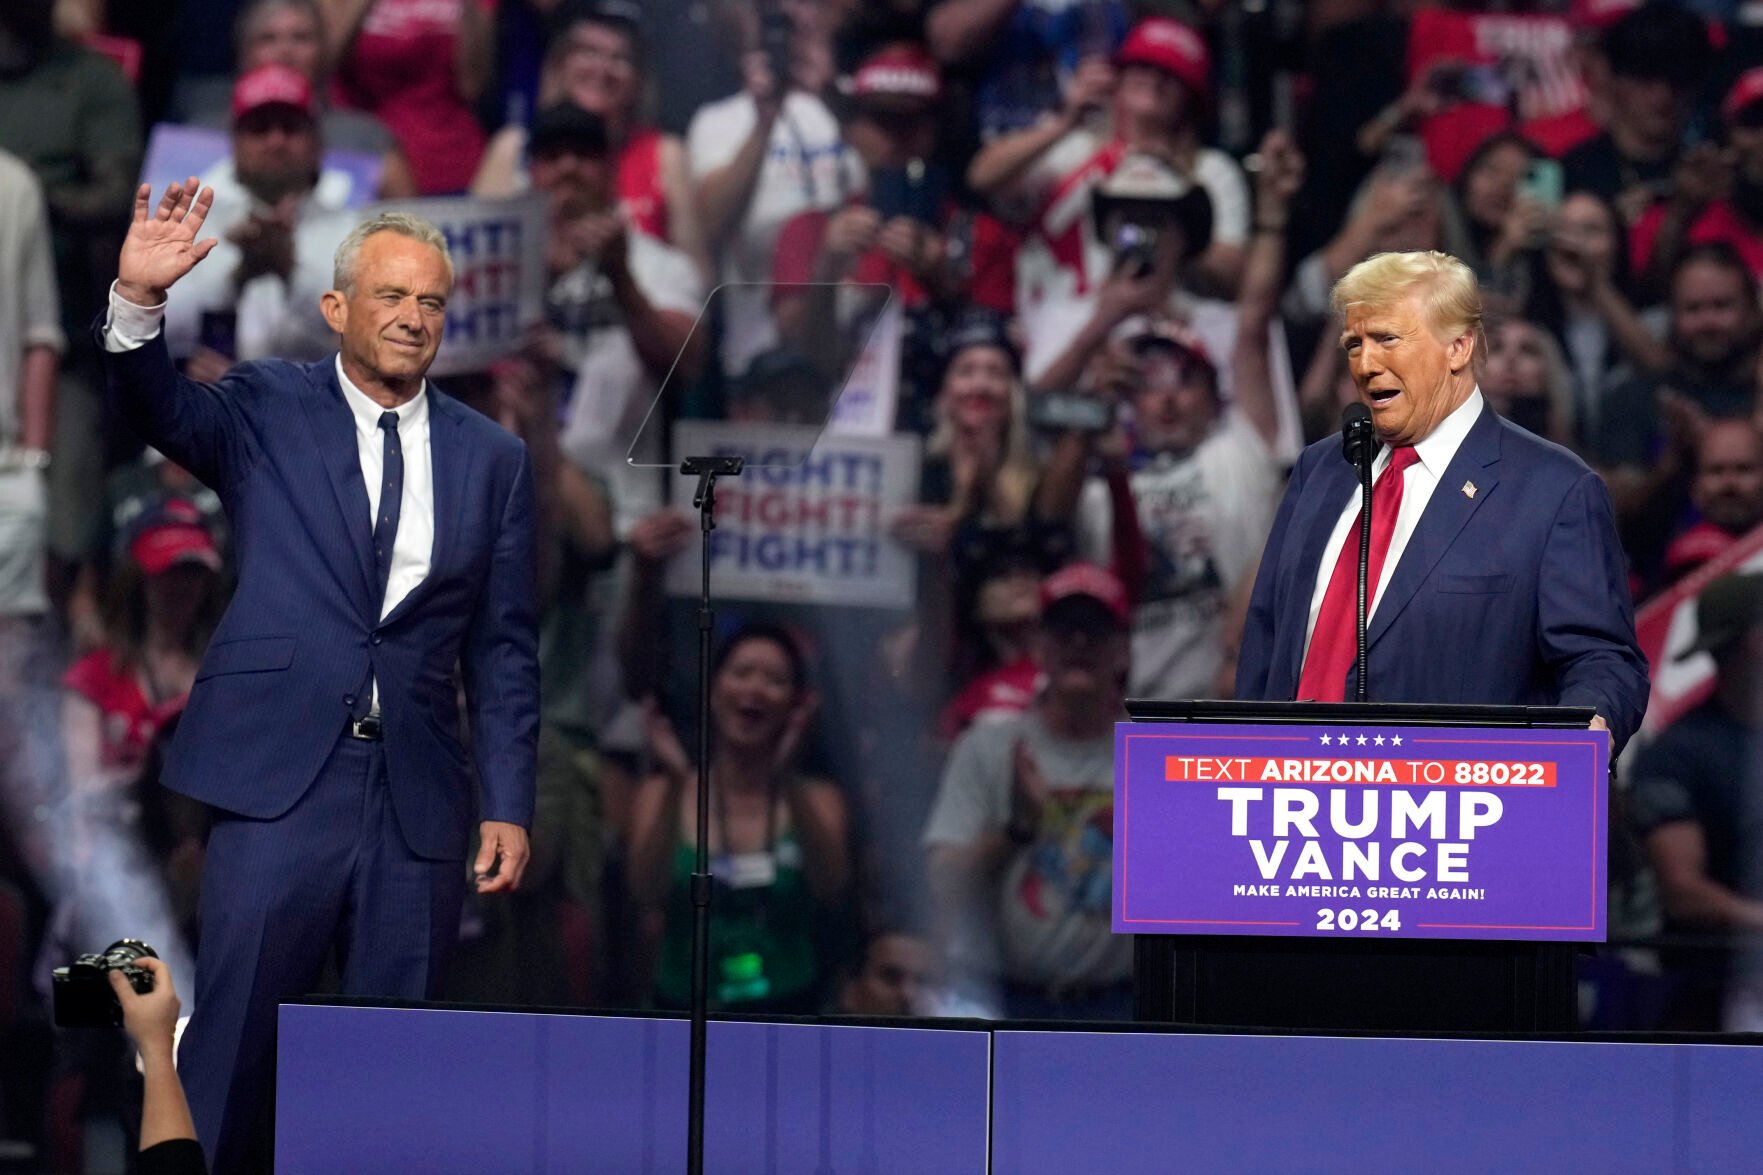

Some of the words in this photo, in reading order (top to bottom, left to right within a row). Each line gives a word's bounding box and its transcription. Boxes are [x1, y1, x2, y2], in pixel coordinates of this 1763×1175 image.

[713, 486, 880, 530] FIGHT!
[709, 530, 880, 577] FIGHT!
[1177, 757, 1252, 781] TEXT
[1260, 758, 1398, 784] ARIZONA
[1406, 761, 1445, 784] TO
[1454, 762, 1545, 785] 88022
[1217, 787, 1504, 840] TRUMP
[1248, 839, 1470, 883] VANCE
[1233, 884, 1280, 897] MAKE
[1285, 885, 1361, 898] AMERICA
[1366, 886, 1421, 899] GREAT
[1426, 887, 1485, 900] AGAIN!
[1316, 908, 1402, 931] 2024
